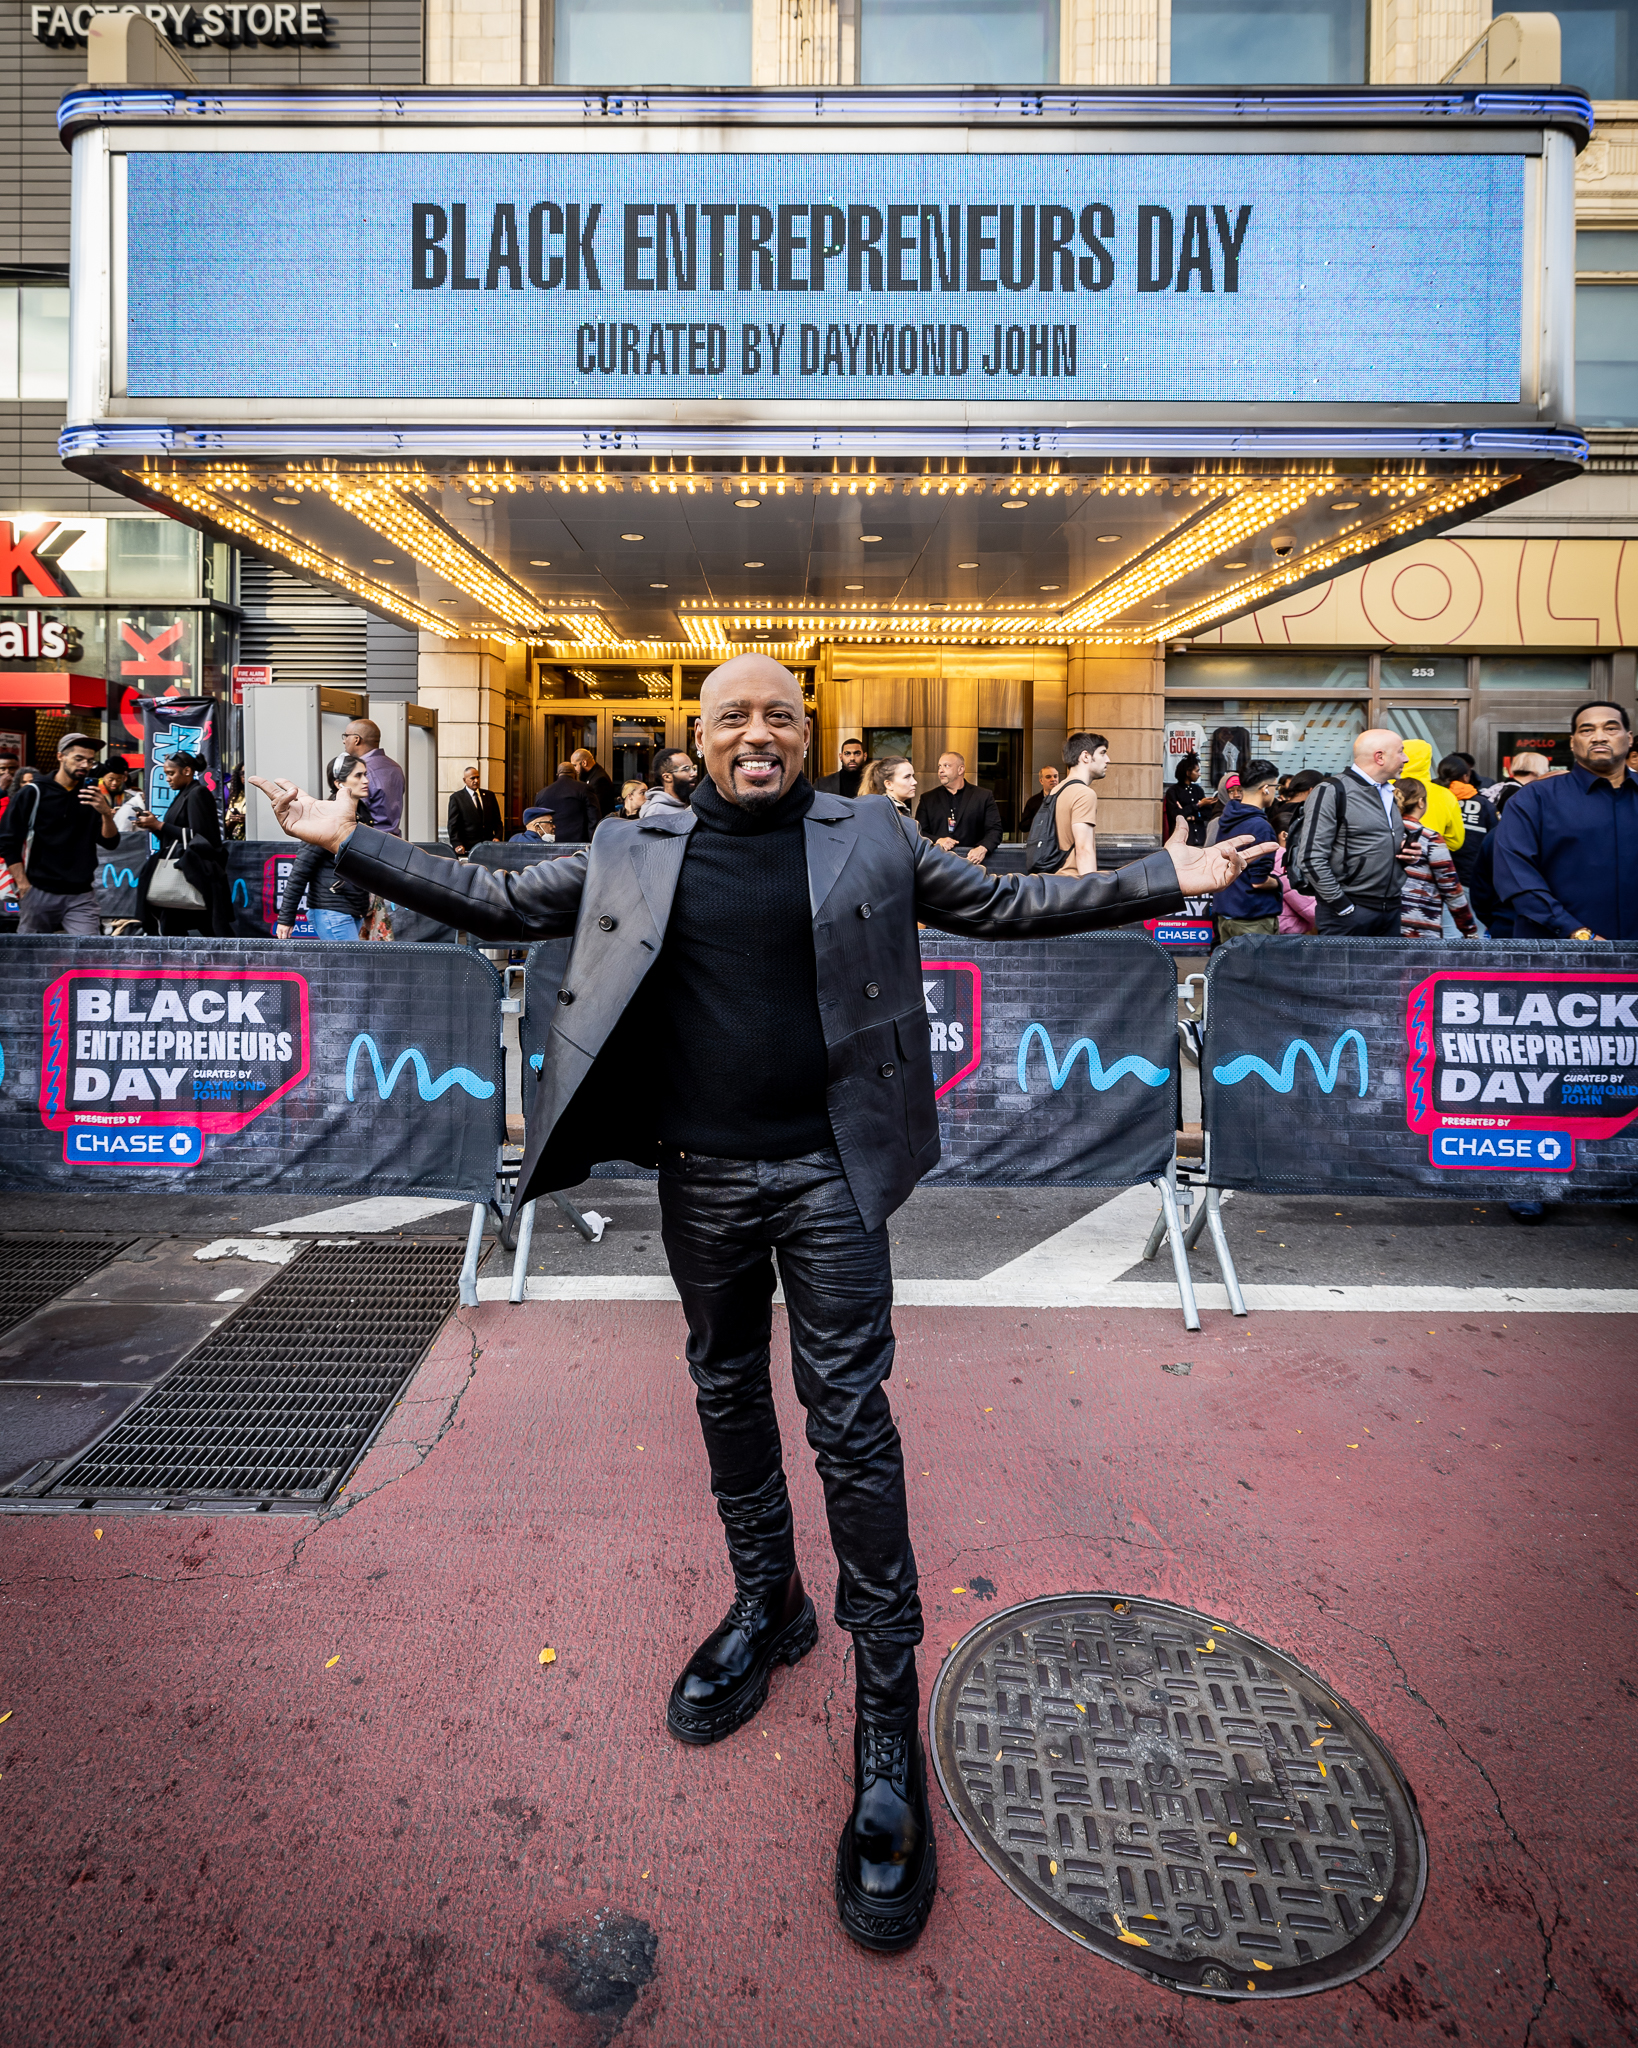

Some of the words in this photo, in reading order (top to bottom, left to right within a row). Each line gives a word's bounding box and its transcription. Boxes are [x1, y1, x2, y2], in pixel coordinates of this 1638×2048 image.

[31, 4, 192, 36] FACRY
[202, 2, 323, 36] STORE
[412, 201, 601, 291] BLACK
[623, 202, 1116, 293] ENTREPRENEURS
[1137, 204, 1254, 293] DAY
[576, 322, 727, 376] CURATED
[741, 323, 785, 376] BY
[800, 323, 970, 377] DAYMOND
[982, 324, 1077, 377] JOHN
[1411, 667, 1435, 677] 253
[1516, 739, 1556, 748] APOLLO
[1165, 900, 1208, 916] AY
[292, 924, 315, 933] ASE
[1158, 930, 1197, 940] CHASE
[76, 988, 266, 1024] BLACK
[1441, 991, 1638, 1028] BLACK
[75, 1029, 293, 1062] ENTREPRENEURS
[1441, 1032, 1638, 1067] ENTREPRENEU
[193, 1069, 237, 1079] CURATED
[238, 1069, 252, 1079] BY
[1563, 1074, 1608, 1084] CURATED
[1610, 1074, 1625, 1084] BY
[72, 1066, 189, 1102] DAY
[193, 1080, 267, 1092] DAYMOND
[1440, 1069, 1560, 1105] DAY
[1561, 1084, 1638, 1097] DAYMOND
[192, 1091, 232, 1101] JOHN
[1561, 1094, 1603, 1106] JOHN
[74, 1114, 127, 1125] PRESENTED
[128, 1114, 142, 1125] BY
[1441, 1116, 1496, 1127] PRESENTED
[1497, 1117, 1511, 1127] BY
[75, 1133, 165, 1153] CHASE
[1440, 1137, 1533, 1158] CHASE
[1144, 1762, 1223, 1940] SEWER
